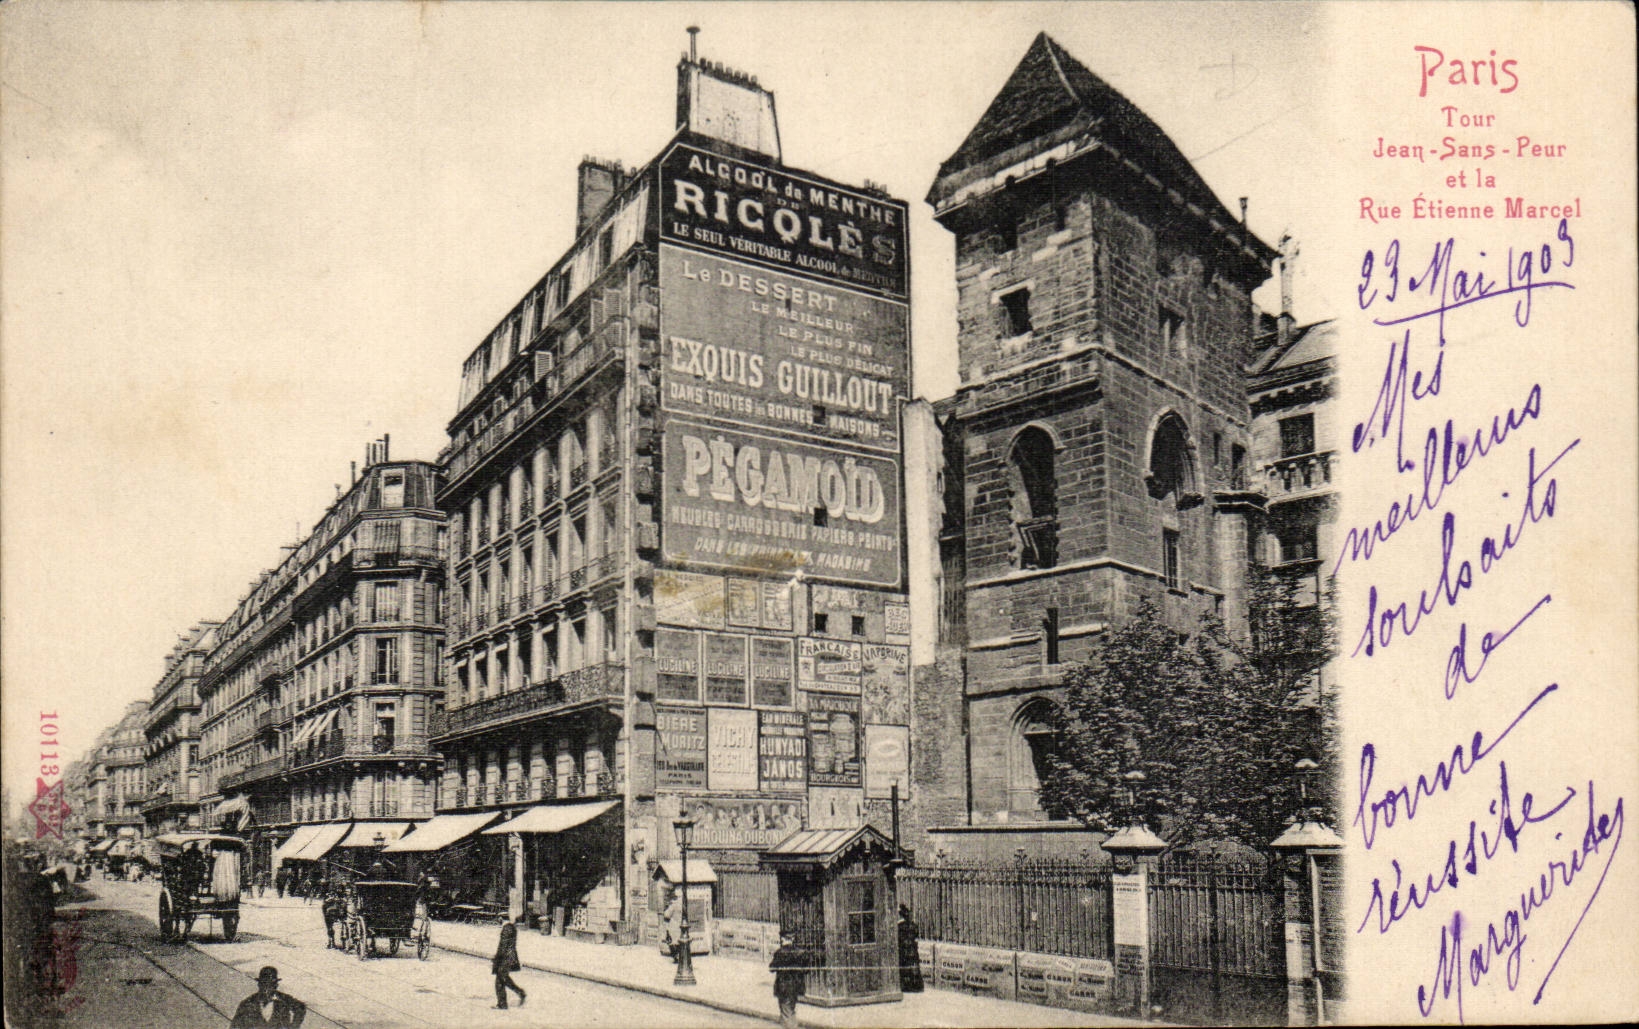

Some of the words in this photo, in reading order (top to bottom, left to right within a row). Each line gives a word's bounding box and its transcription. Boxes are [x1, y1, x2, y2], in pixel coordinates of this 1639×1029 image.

[688, 154, 778, 193] ALCOOL
[809, 188, 896, 225] MENTHE
[673, 221, 690, 237] LE
[694, 226, 726, 246] SEUL
[729, 234, 792, 263] VÉRITABLE
[796, 255, 839, 274] ALCOOL
[683, 259, 710, 282] Le
[719, 268, 838, 312] DESSERT
[752, 300, 770, 315] LE
[775, 306, 854, 334] MEILLEUR
[779, 325, 798, 338] LE
[802, 330, 843, 348] PLUS
[848, 341, 873, 356] FIN
[669, 336, 764, 388] EXQUIS
[777, 360, 894, 415] GUILLOUT
[808, 350, 843, 366] PLUS
[670, 382, 702, 403] DANS
[707, 390, 753, 414] TOUTES
[767, 402, 814, 425] BONNES
[829, 415, 880, 438] MAISONS
[1352, 328, 1445, 473] Mes
[1445, 594, 1552, 700] de
